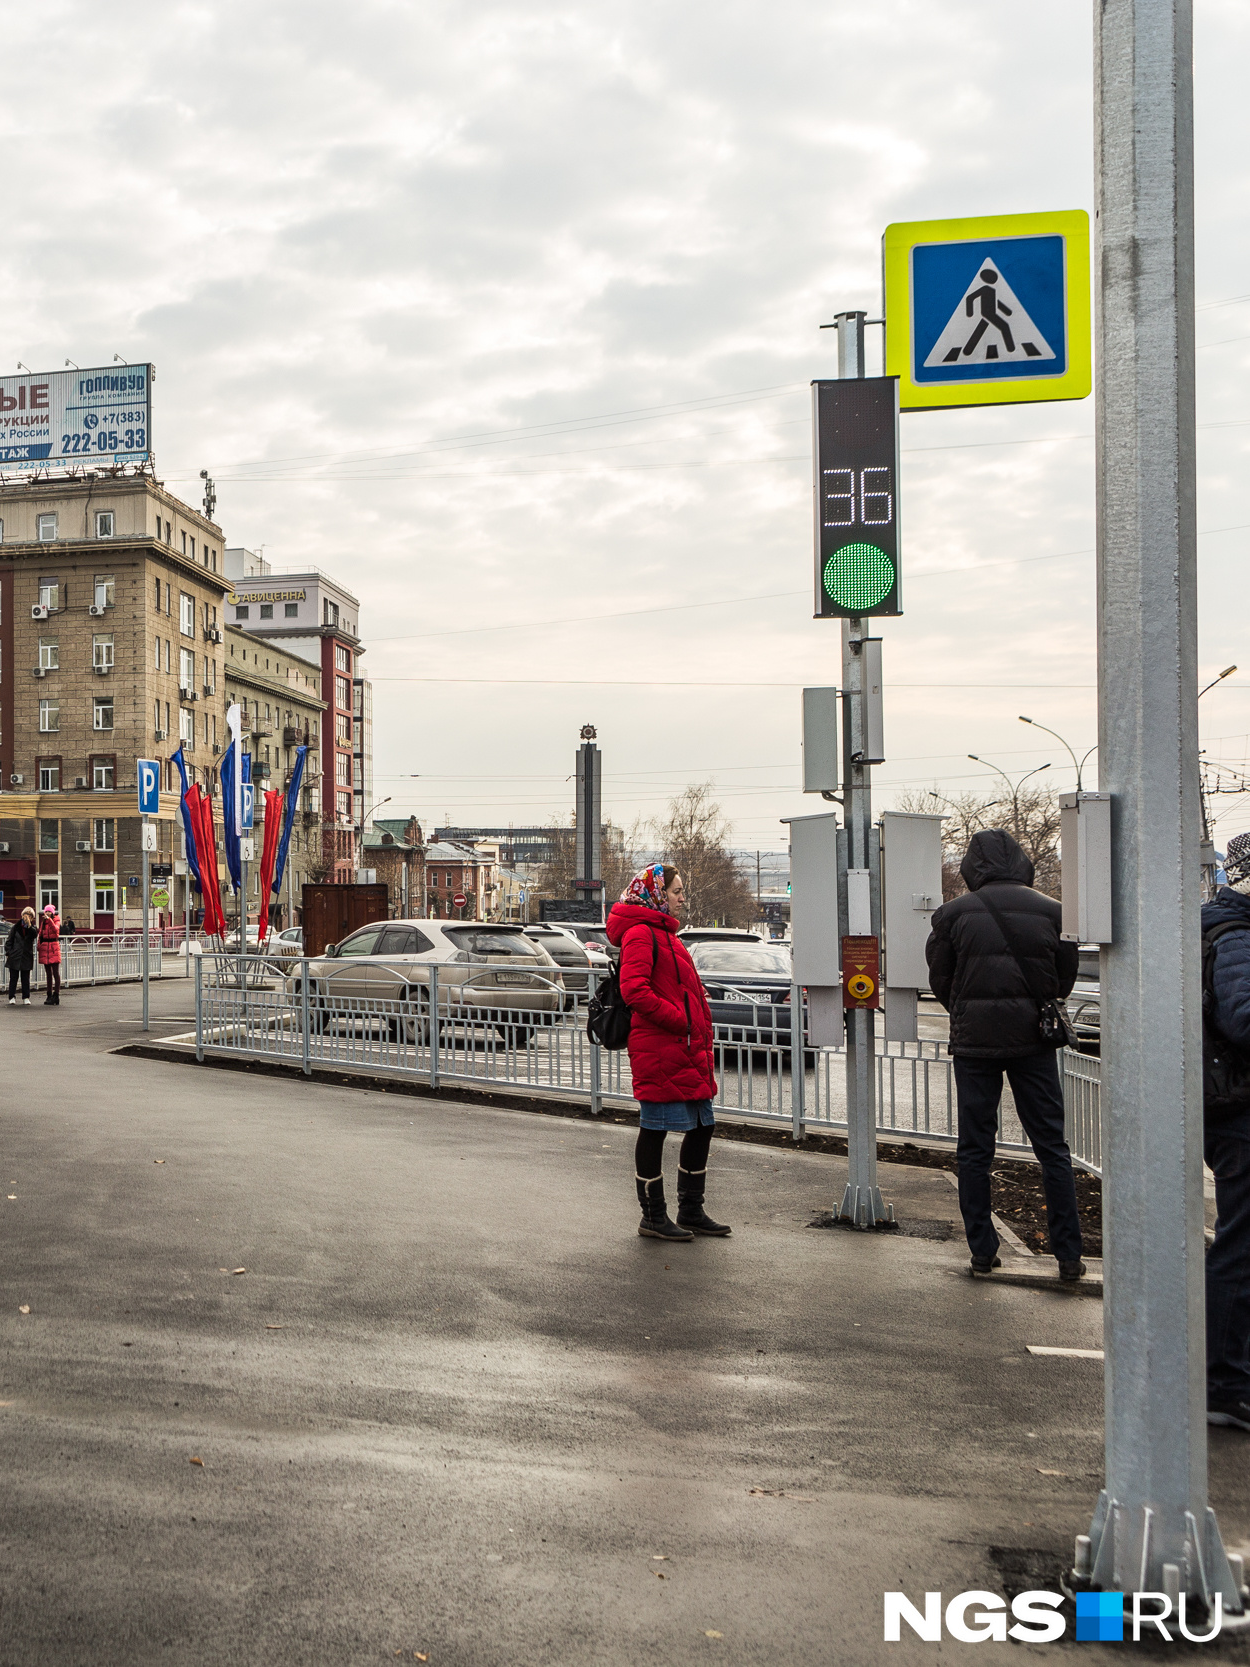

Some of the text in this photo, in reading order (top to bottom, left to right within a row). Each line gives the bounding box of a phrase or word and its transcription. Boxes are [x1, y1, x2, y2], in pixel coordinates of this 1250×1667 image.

[102, 411, 145, 426] +7(383)
[9, 428, 50, 438] России
[61, 428, 145, 453] 222-05-33
[18, 459, 67, 470] 222-05-33
[73, 457, 109, 466] РЕКЛАМЫ
[824, 467, 892, 527] 36
[242, 590, 307, 603] АВИЦЕННА
